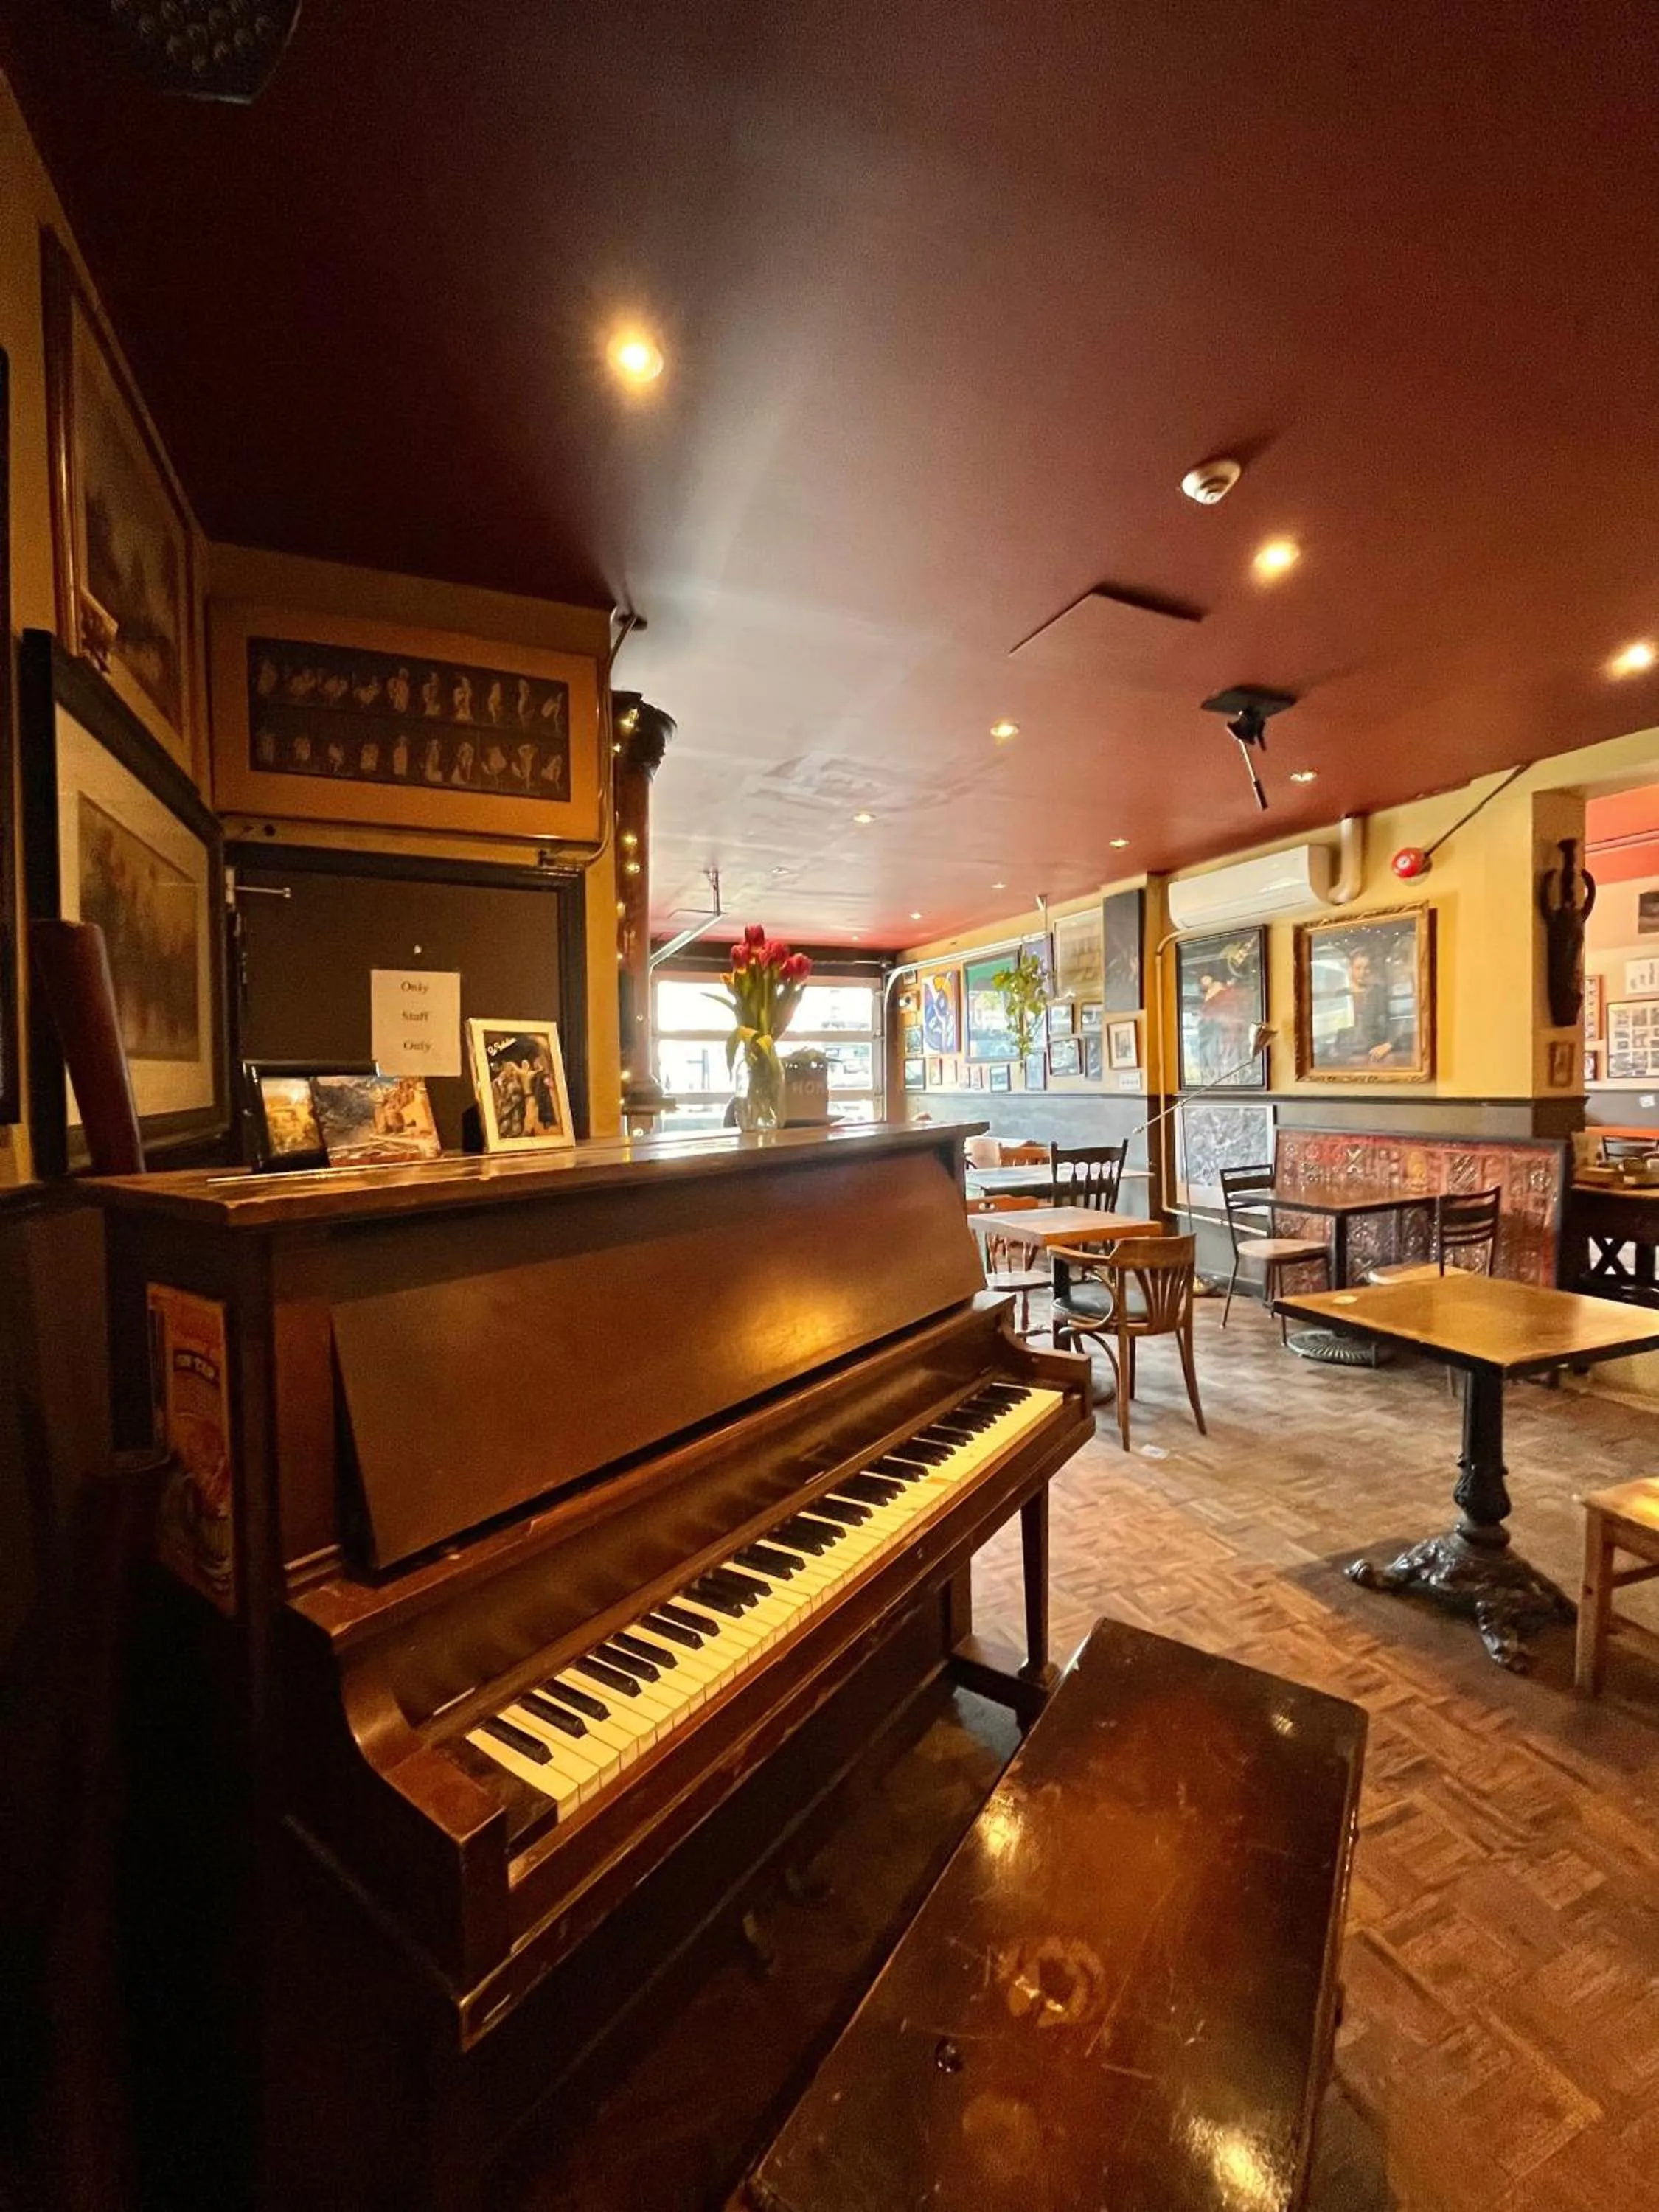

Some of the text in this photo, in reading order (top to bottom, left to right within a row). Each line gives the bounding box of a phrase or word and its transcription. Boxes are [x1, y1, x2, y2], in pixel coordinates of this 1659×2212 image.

[401, 981, 428, 995] Only
[402, 1010, 431, 1021] Staff
[403, 1040, 431, 1053] Only
